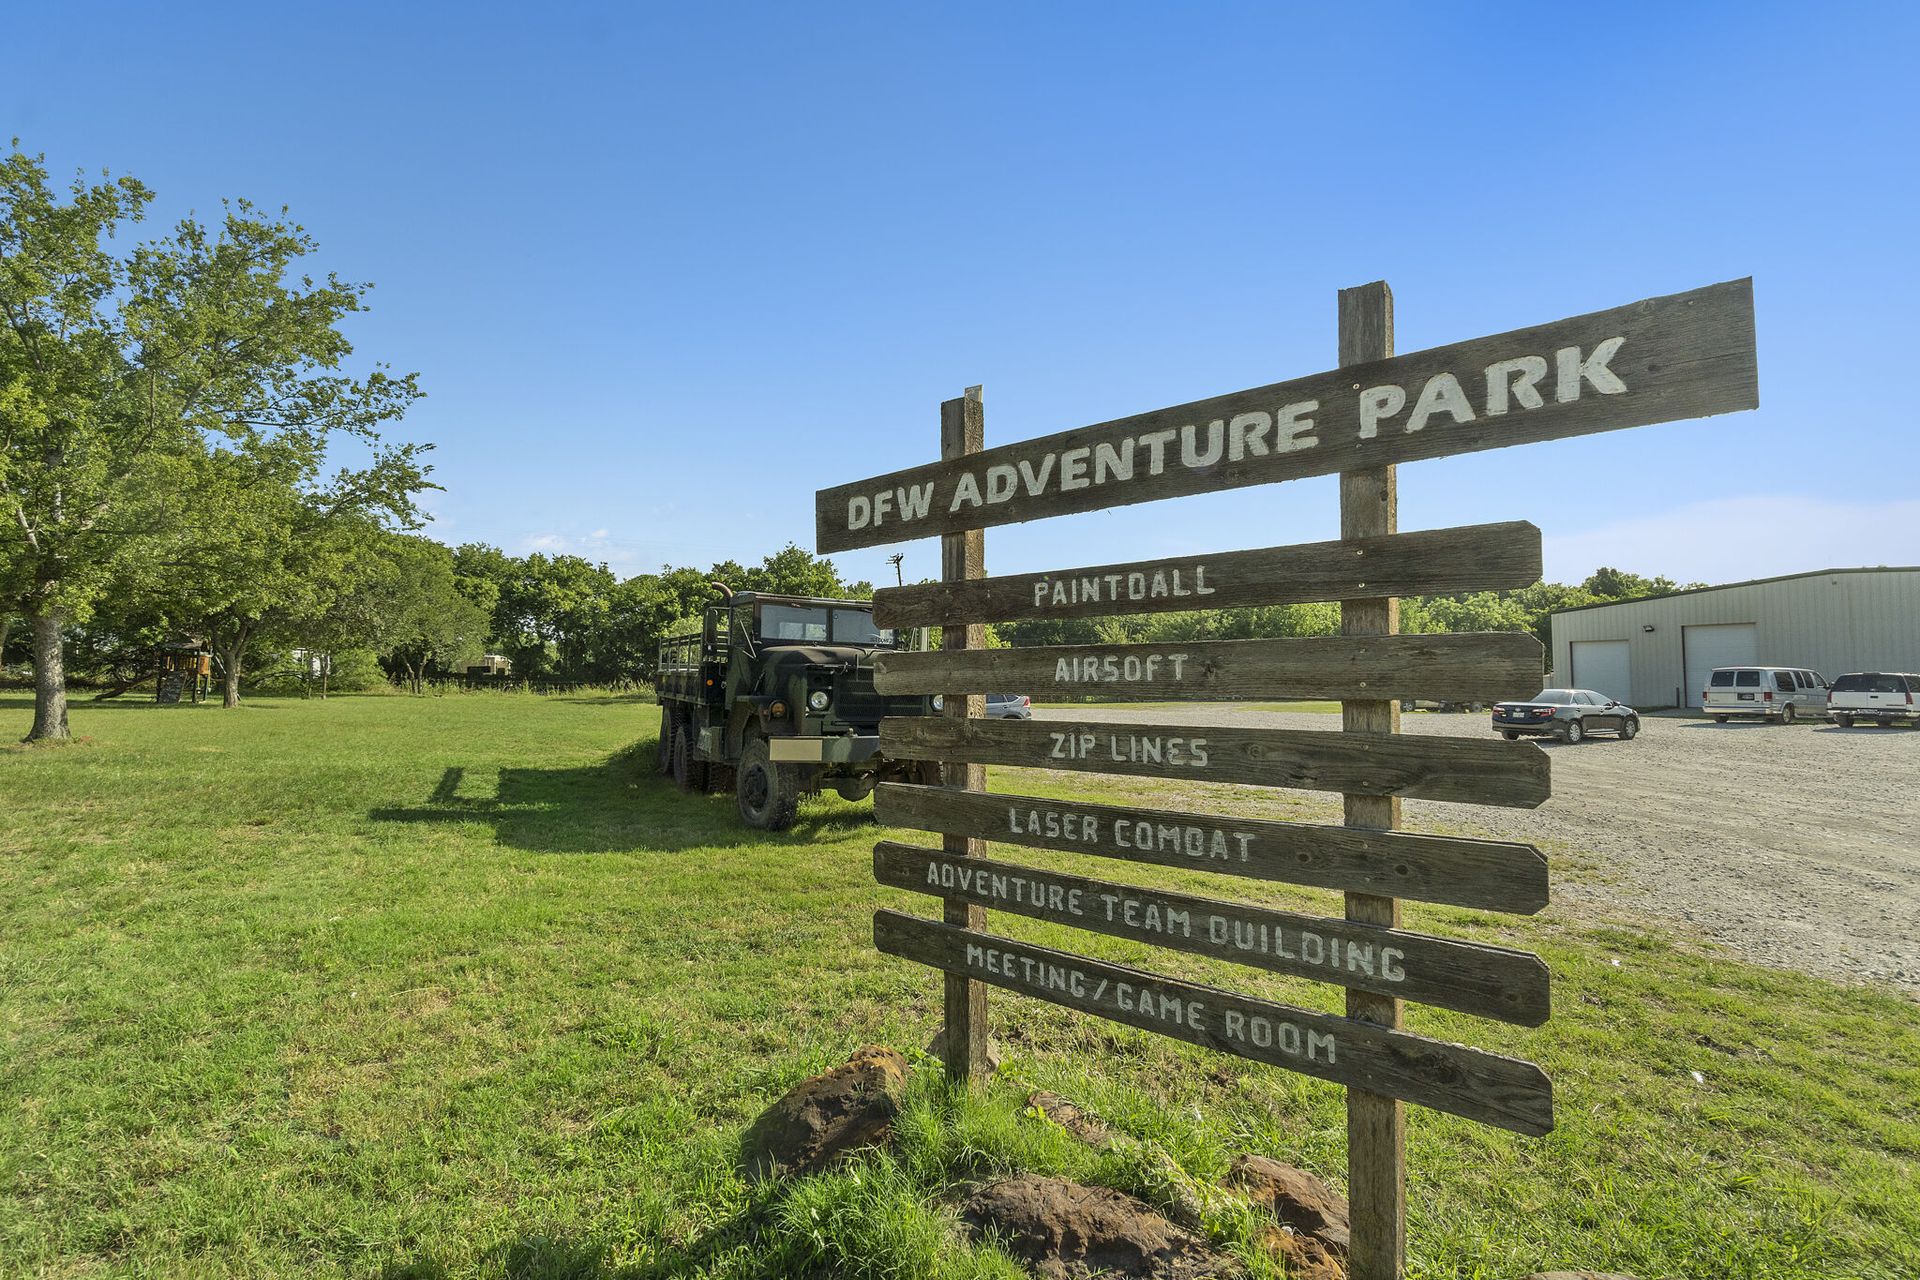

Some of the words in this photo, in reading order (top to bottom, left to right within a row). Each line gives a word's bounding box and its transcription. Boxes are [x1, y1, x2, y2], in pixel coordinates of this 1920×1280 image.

[848, 483, 934, 530] DFW
[949, 400, 1319, 512] ADVENTURE
[1359, 336, 1627, 439] PARK
[1055, 653, 1188, 682] AIRSOFT
[1050, 732, 1096, 759] ZIP
[1111, 736, 1208, 767] LINES
[1009, 808, 1098, 842] LASER
[927, 862, 1083, 915] ADVENTURE
[1102, 895, 1191, 937] TEAM
[1210, 916, 1405, 981] BUILDING
[1226, 1010, 1336, 1064] ROOM
